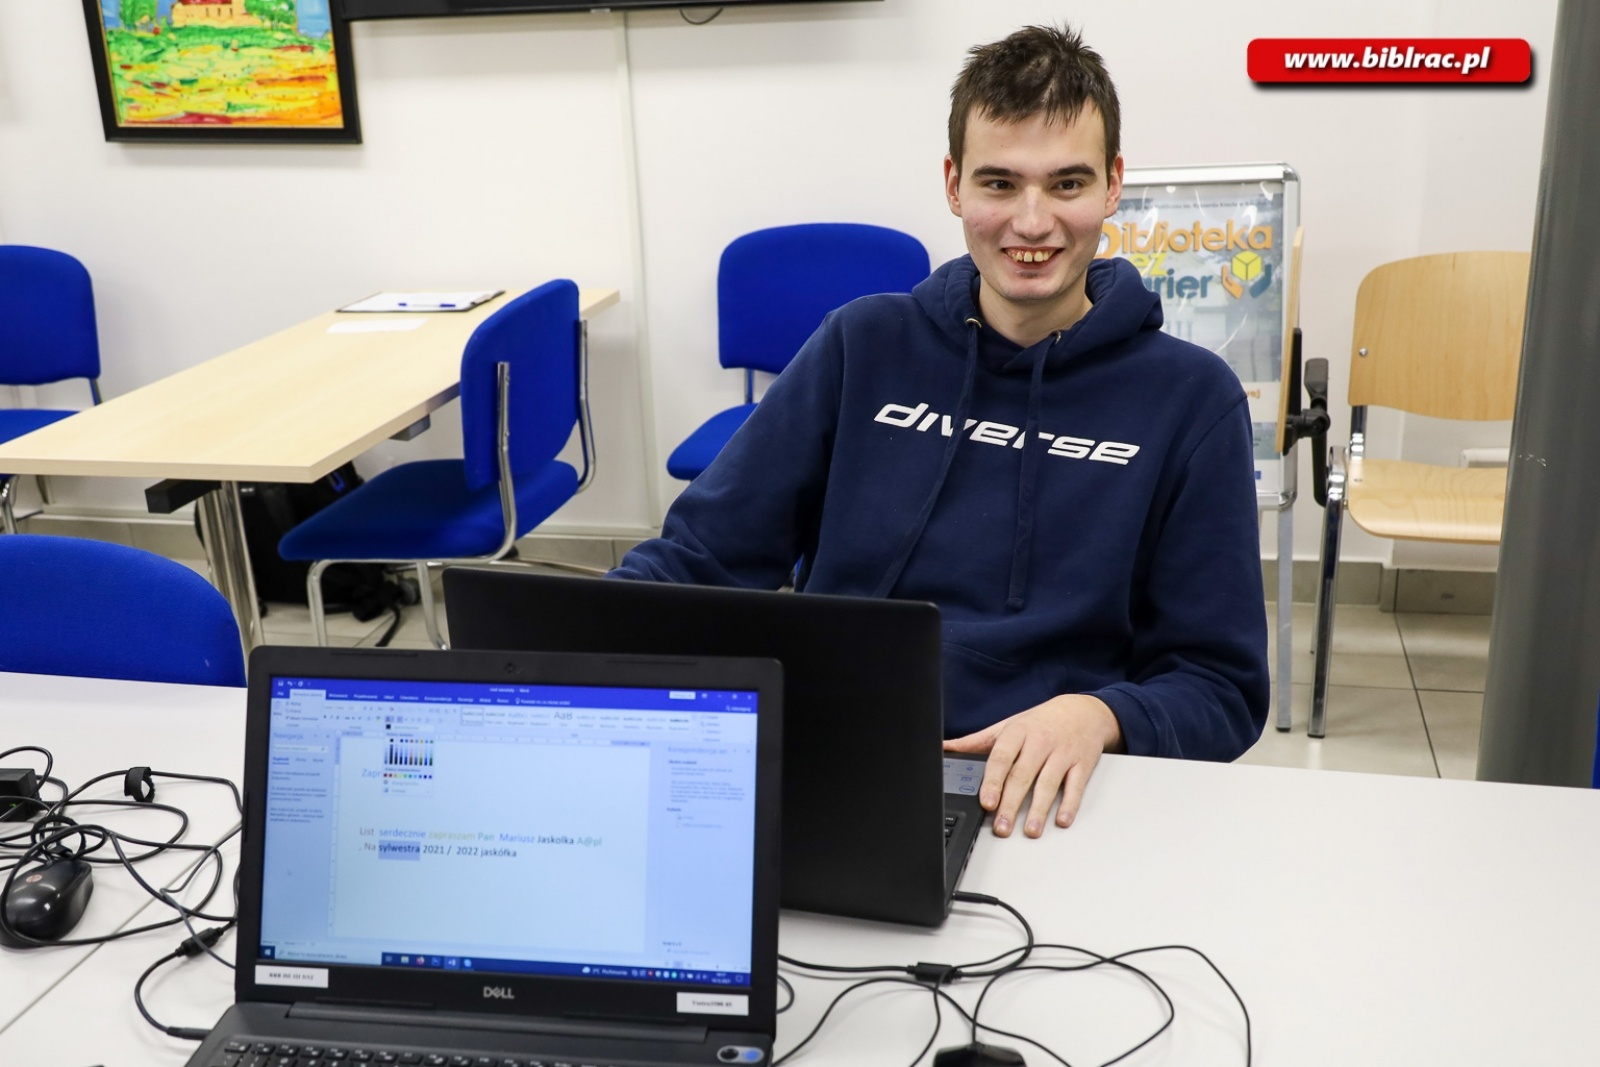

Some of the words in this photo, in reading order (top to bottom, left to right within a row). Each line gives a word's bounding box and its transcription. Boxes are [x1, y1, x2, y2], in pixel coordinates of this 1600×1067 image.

[1144, 268, 1213, 299] rier
[874, 402, 1140, 465] diverse
[361, 768, 381, 780] Zapr
[359, 827, 375, 836] List
[379, 828, 426, 839] serdecznie
[428, 831, 475, 841] zapraszam
[478, 832, 495, 841] Pan
[499, 833, 535, 843] Mariusz
[364, 842, 376, 851] Na
[378, 842, 420, 854] sylwestra
[422, 844, 445, 855] 2021
[456, 845, 478, 856] 2022
[483, 986, 515, 1000] DELL
